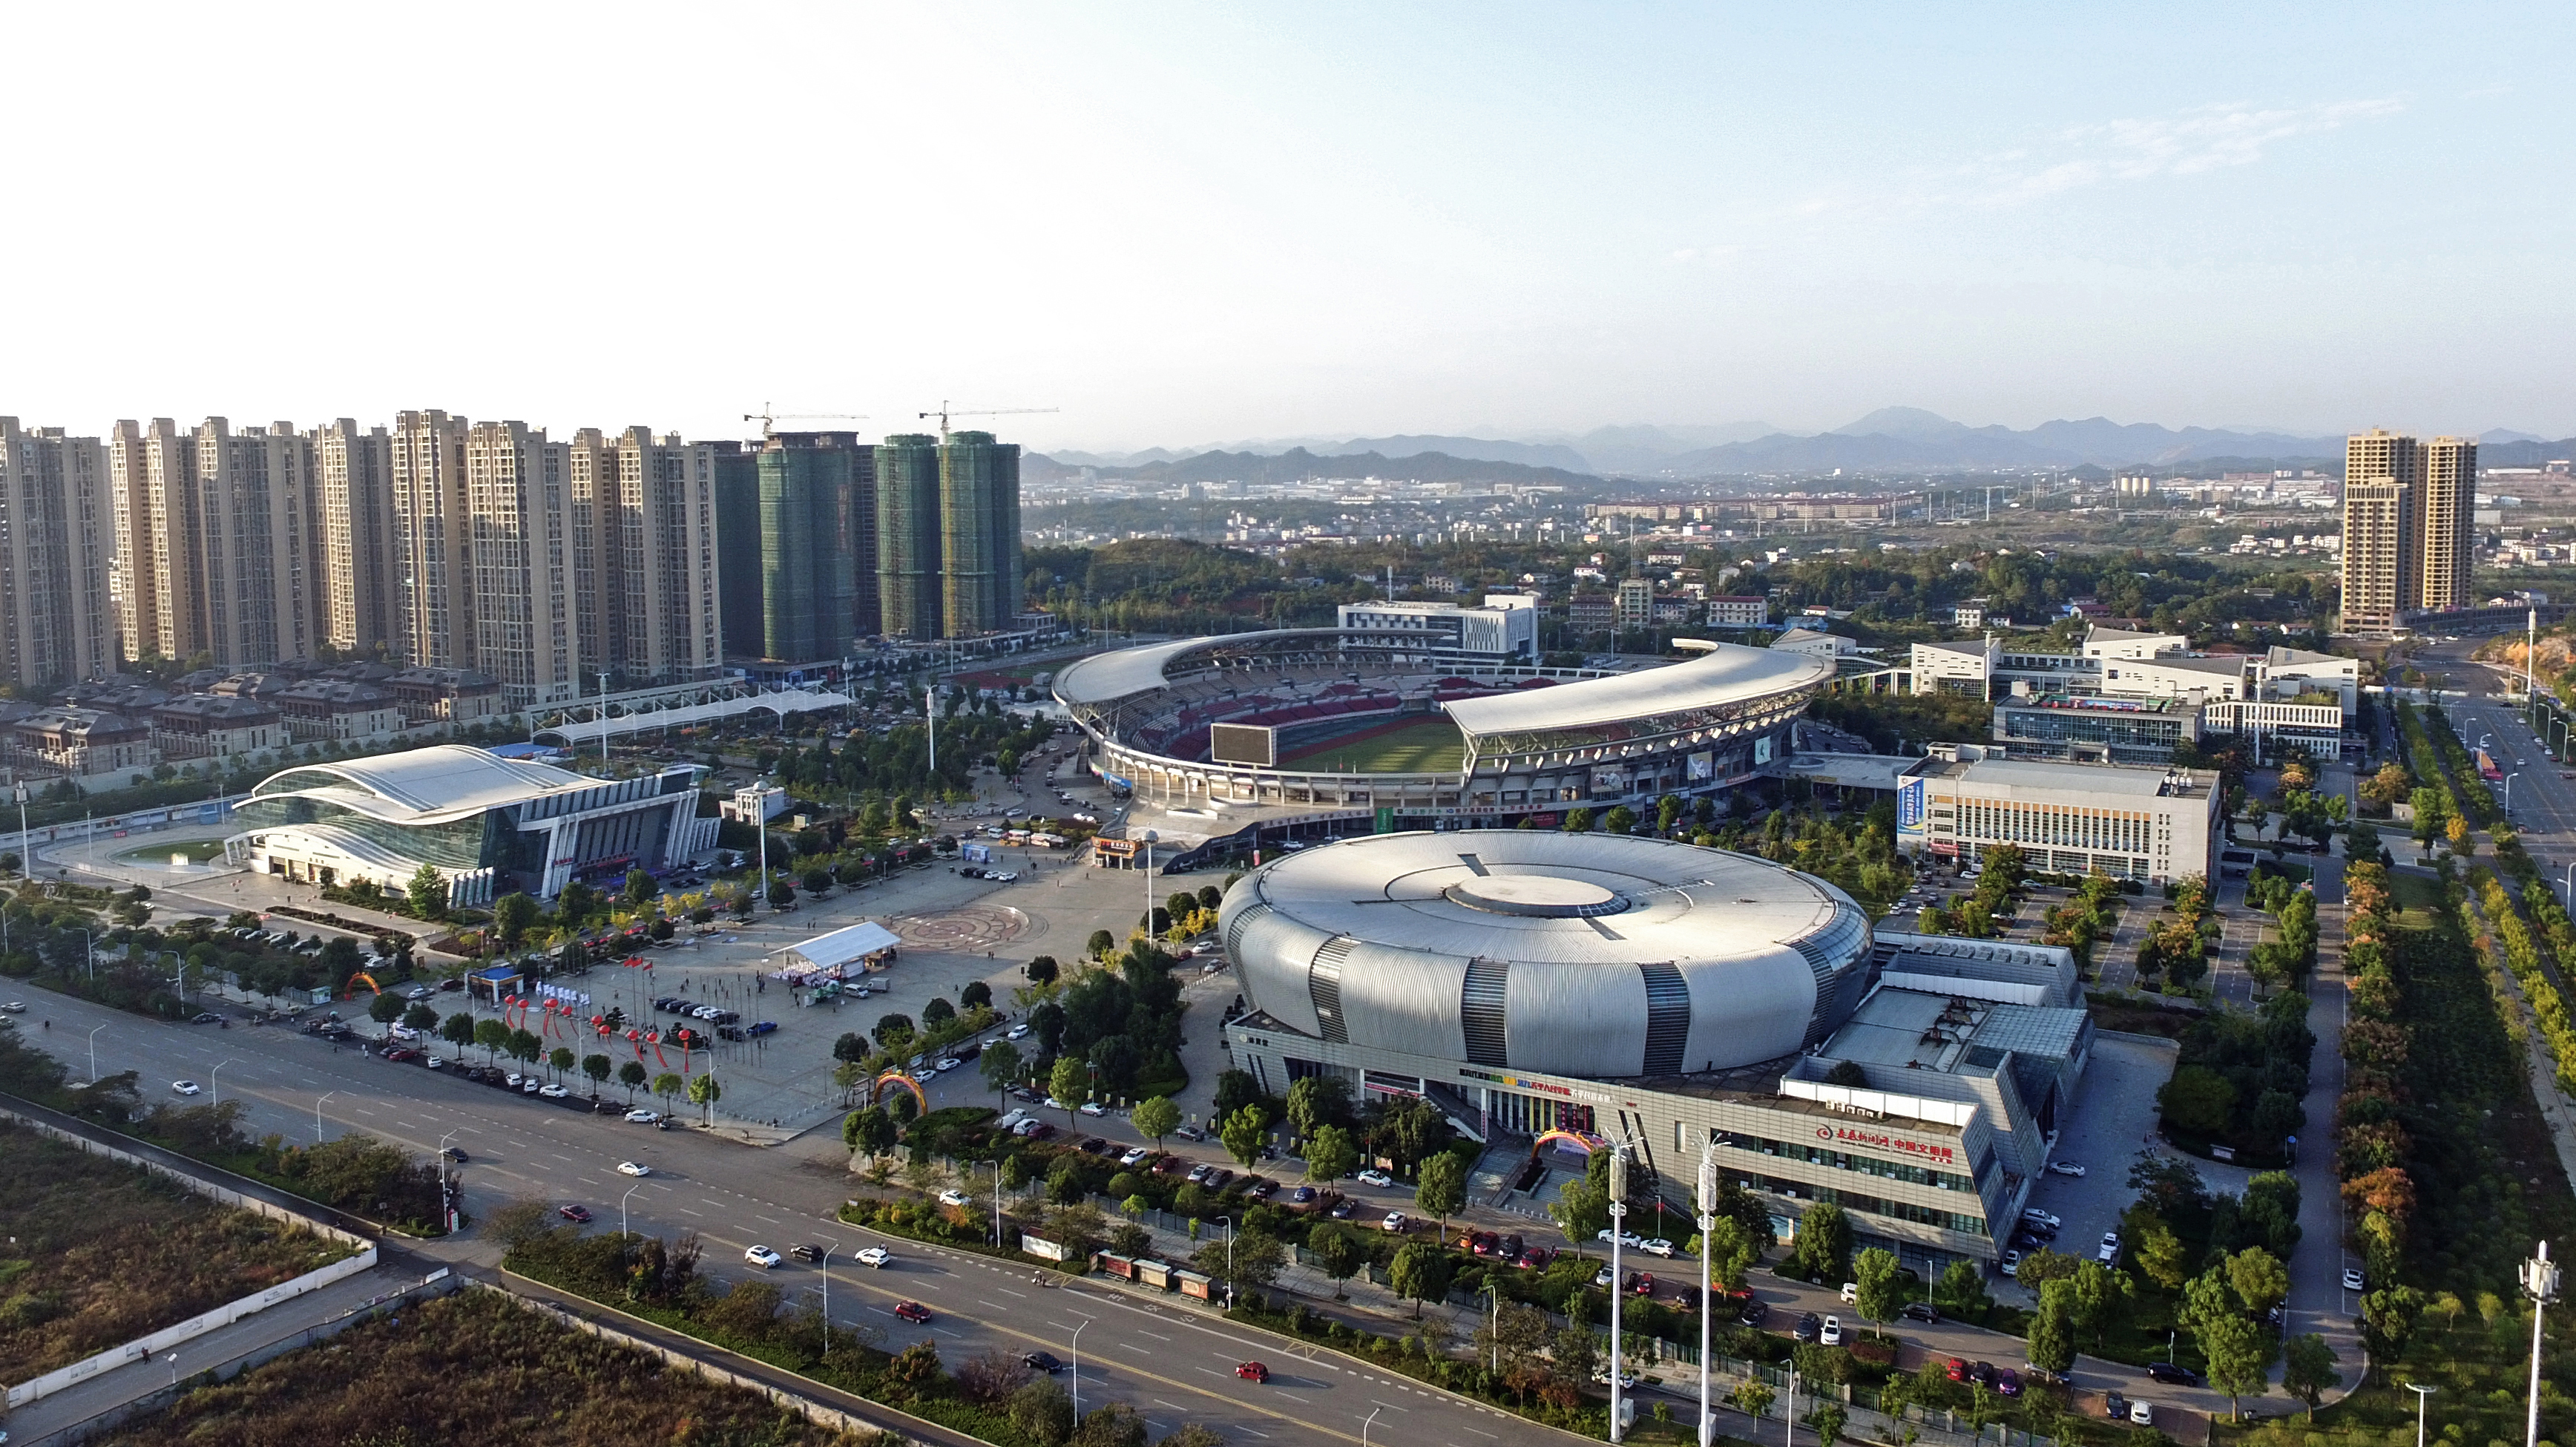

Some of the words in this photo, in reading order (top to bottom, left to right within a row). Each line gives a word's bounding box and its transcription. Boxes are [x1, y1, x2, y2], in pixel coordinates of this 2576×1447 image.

[1893, 1138, 1953, 1158] 中国文明网
